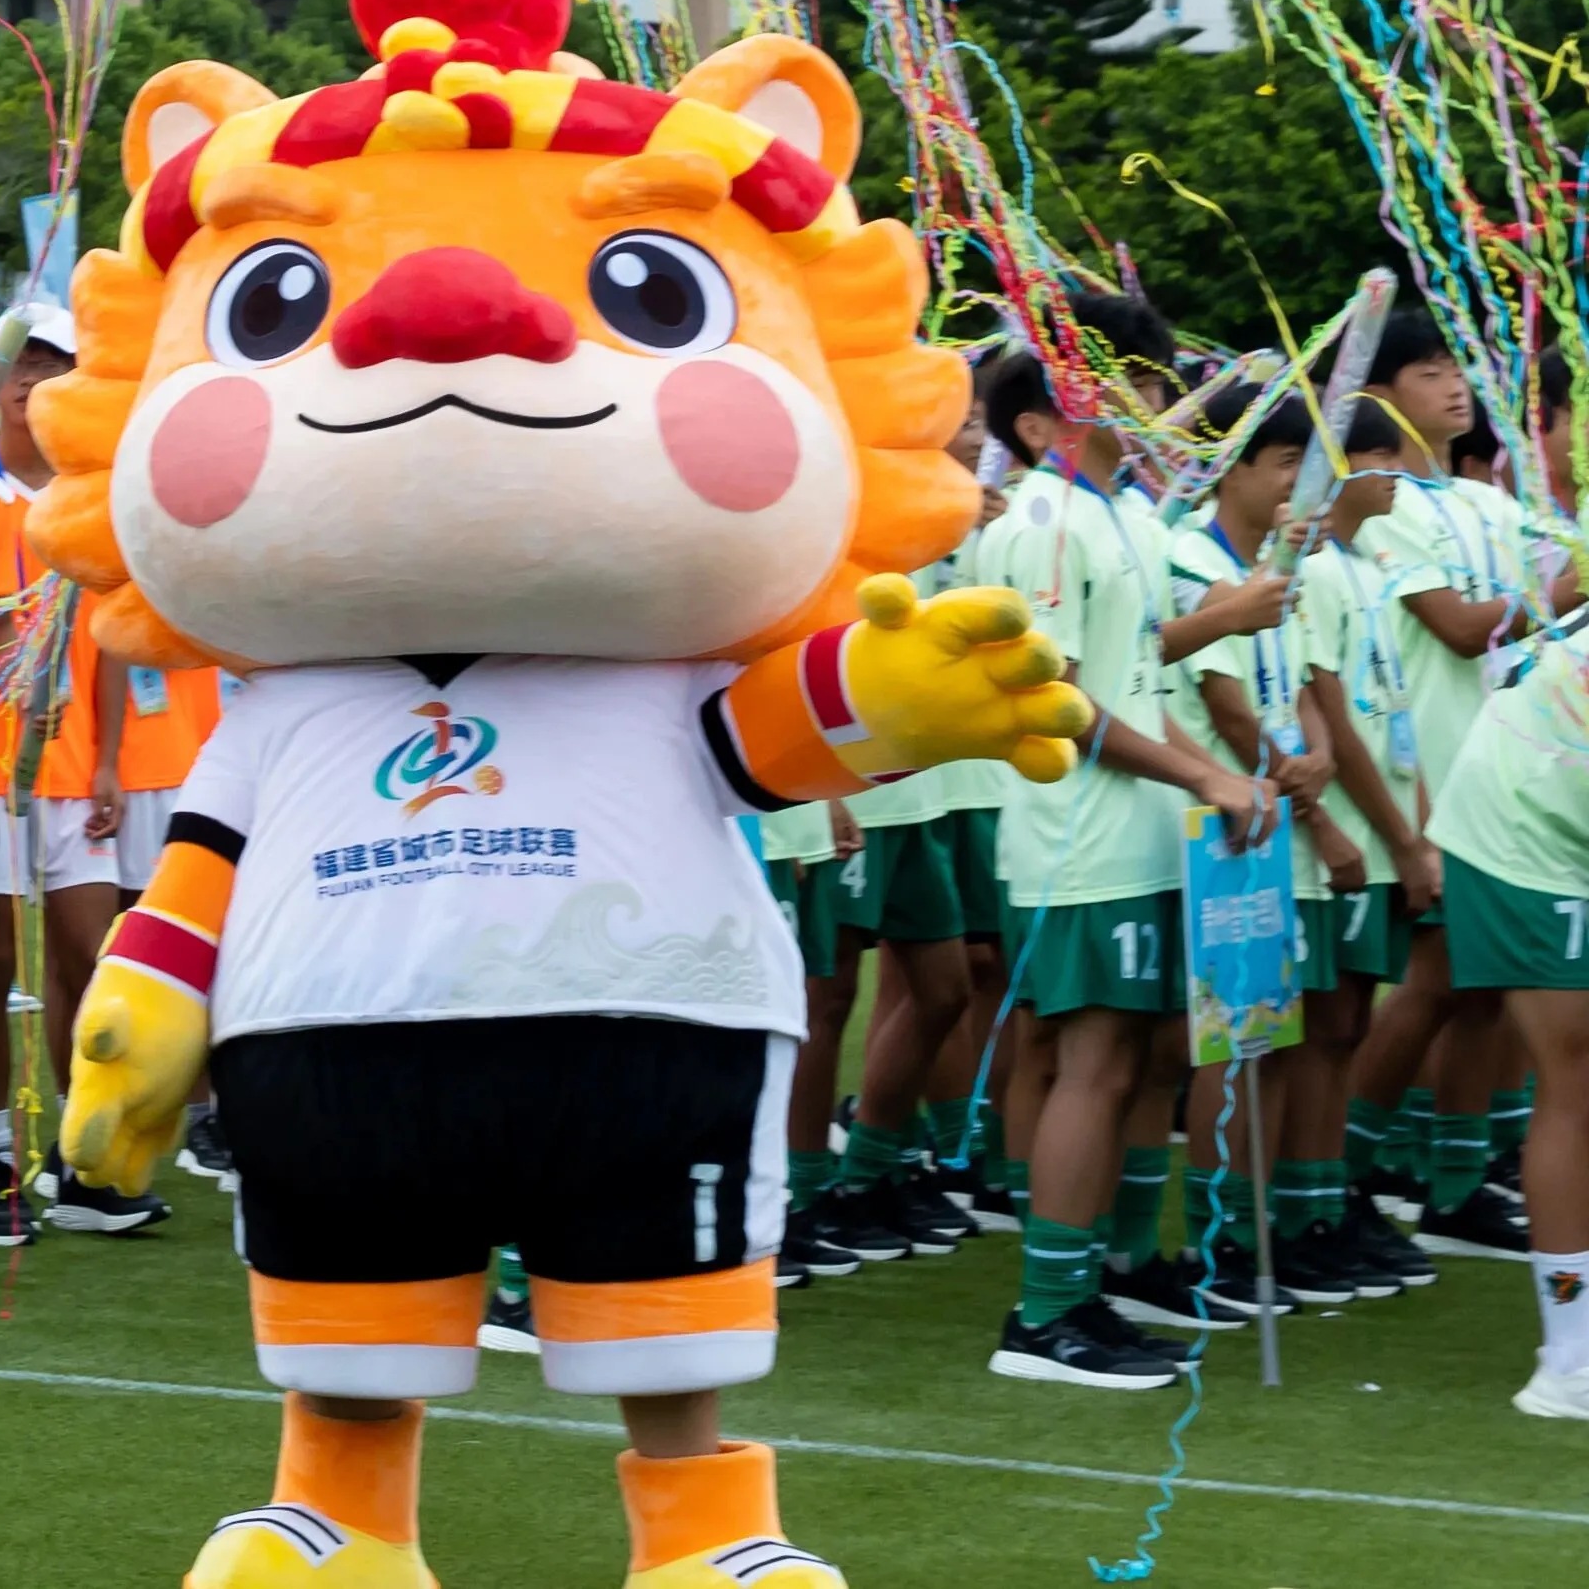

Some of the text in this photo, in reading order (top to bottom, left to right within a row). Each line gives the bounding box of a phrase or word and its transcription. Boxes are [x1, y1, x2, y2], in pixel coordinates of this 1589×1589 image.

[313, 826, 578, 880] 福建省城市足球联赛
[839, 849, 868, 899] 4
[318, 861, 578, 900] FUJIAN FOOTBALL CITY LEAGUE
[1342, 892, 1372, 942] 7
[1111, 920, 1161, 980] 12
[688, 1162, 725, 1262] 1
